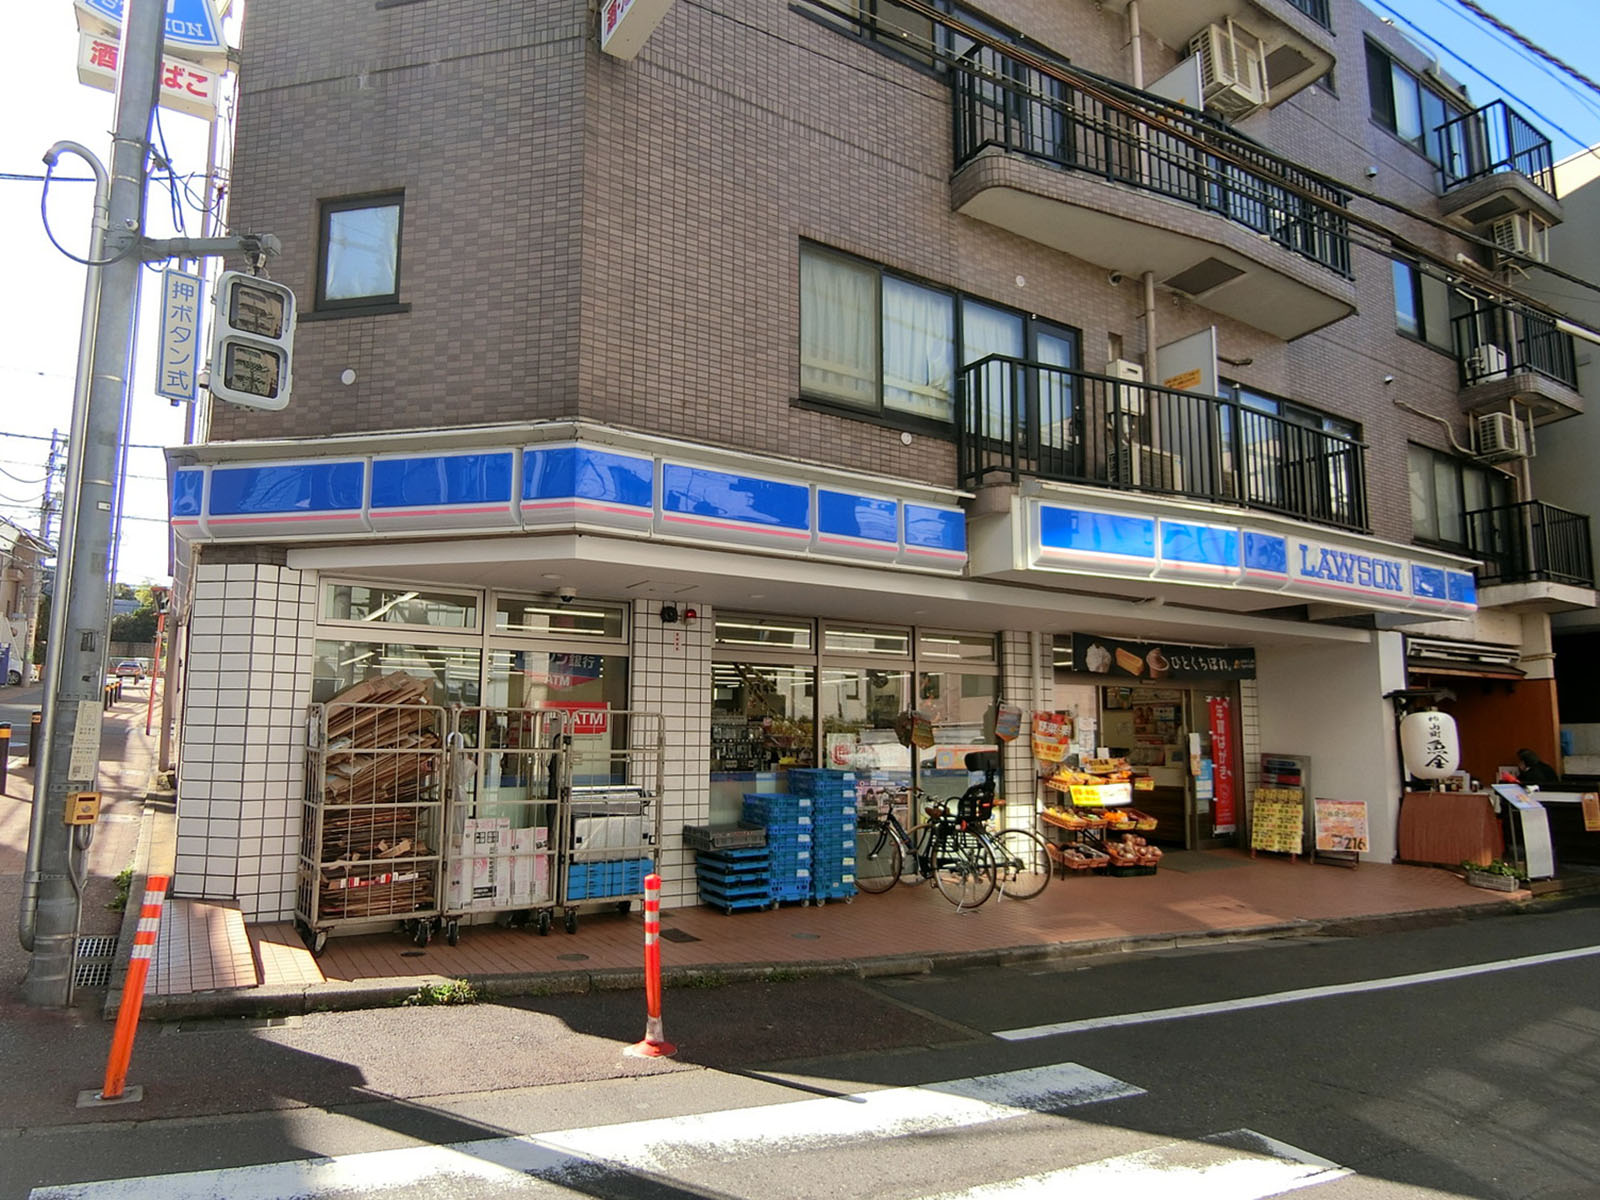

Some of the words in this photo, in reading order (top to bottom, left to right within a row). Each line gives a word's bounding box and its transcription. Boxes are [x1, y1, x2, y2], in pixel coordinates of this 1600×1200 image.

[159, 61, 208, 98] ばこ
[166, 280, 195, 391] 押ボタン式
[1299, 543, 1404, 592] LAWSON
[543, 674, 571, 687] ATM
[572, 711, 605, 725] ATM
[1344, 836, 1366, 851] 216
